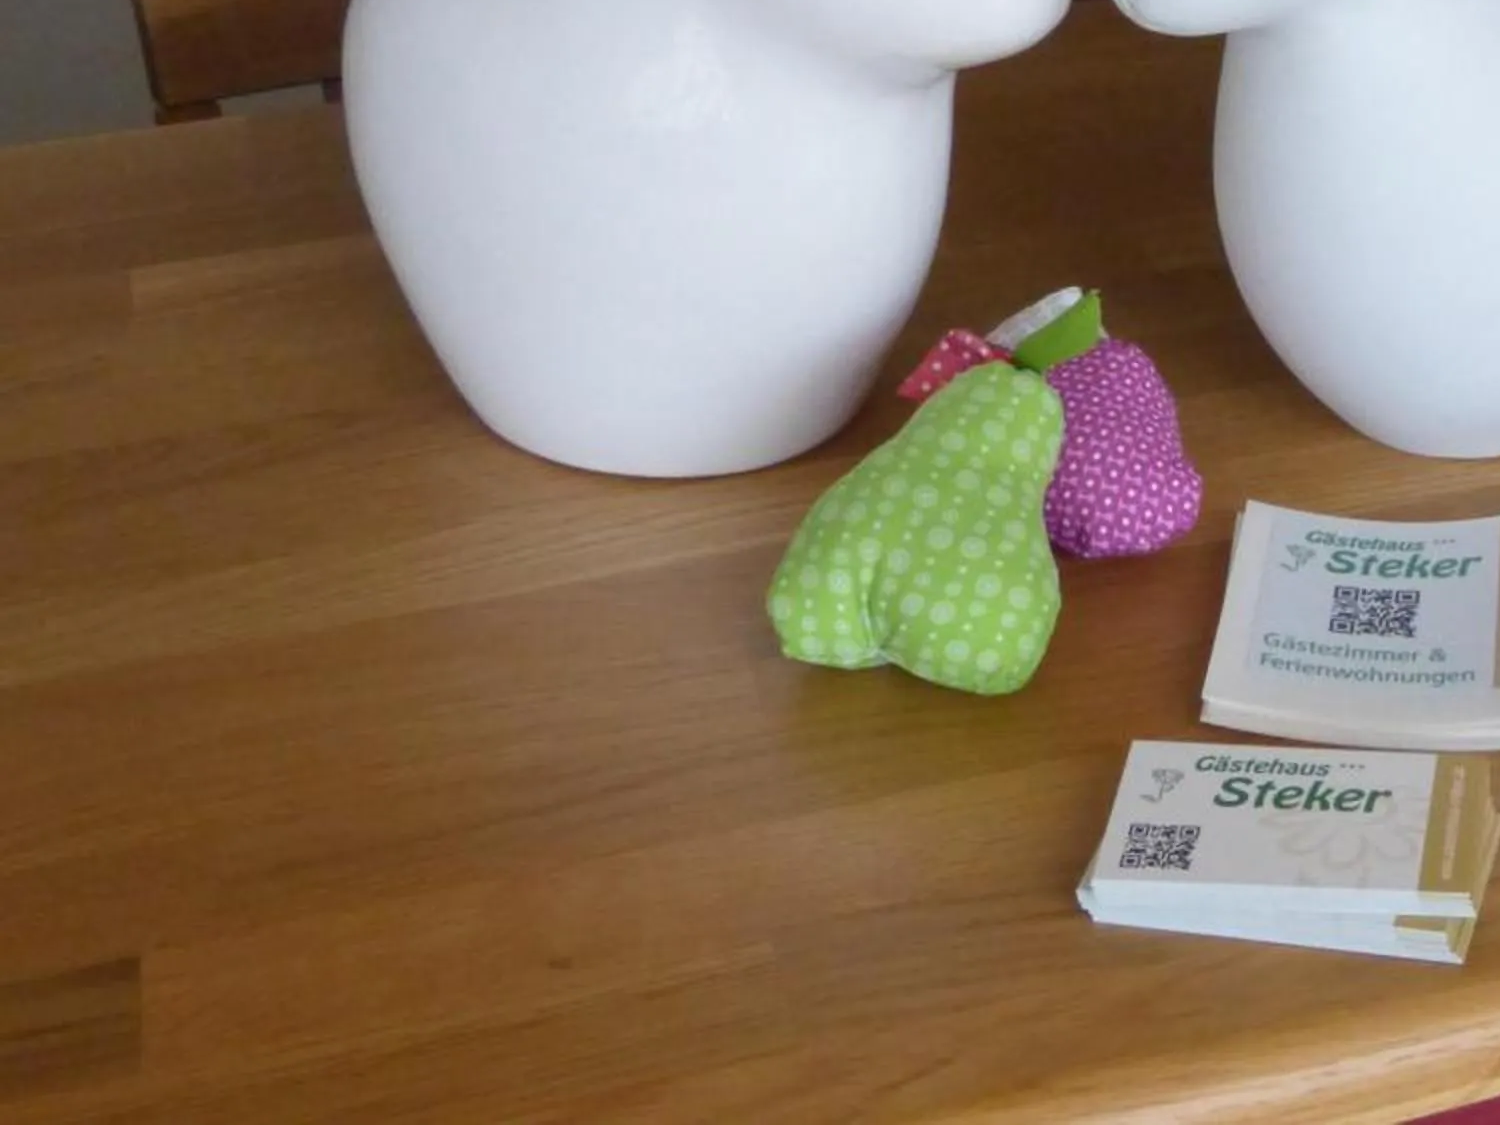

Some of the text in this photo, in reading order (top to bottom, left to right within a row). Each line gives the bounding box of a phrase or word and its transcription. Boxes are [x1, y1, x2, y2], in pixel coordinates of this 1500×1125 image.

[1304, 530, 1425, 551] Gästehaus
[1324, 550, 1482, 578] Steker
[1262, 631, 1447, 663] Gästezimmer &
[1258, 651, 1476, 688] Ferienwohnungen
[1194, 755, 1330, 776] Gästehaus
[1213, 776, 1392, 813] Steker
